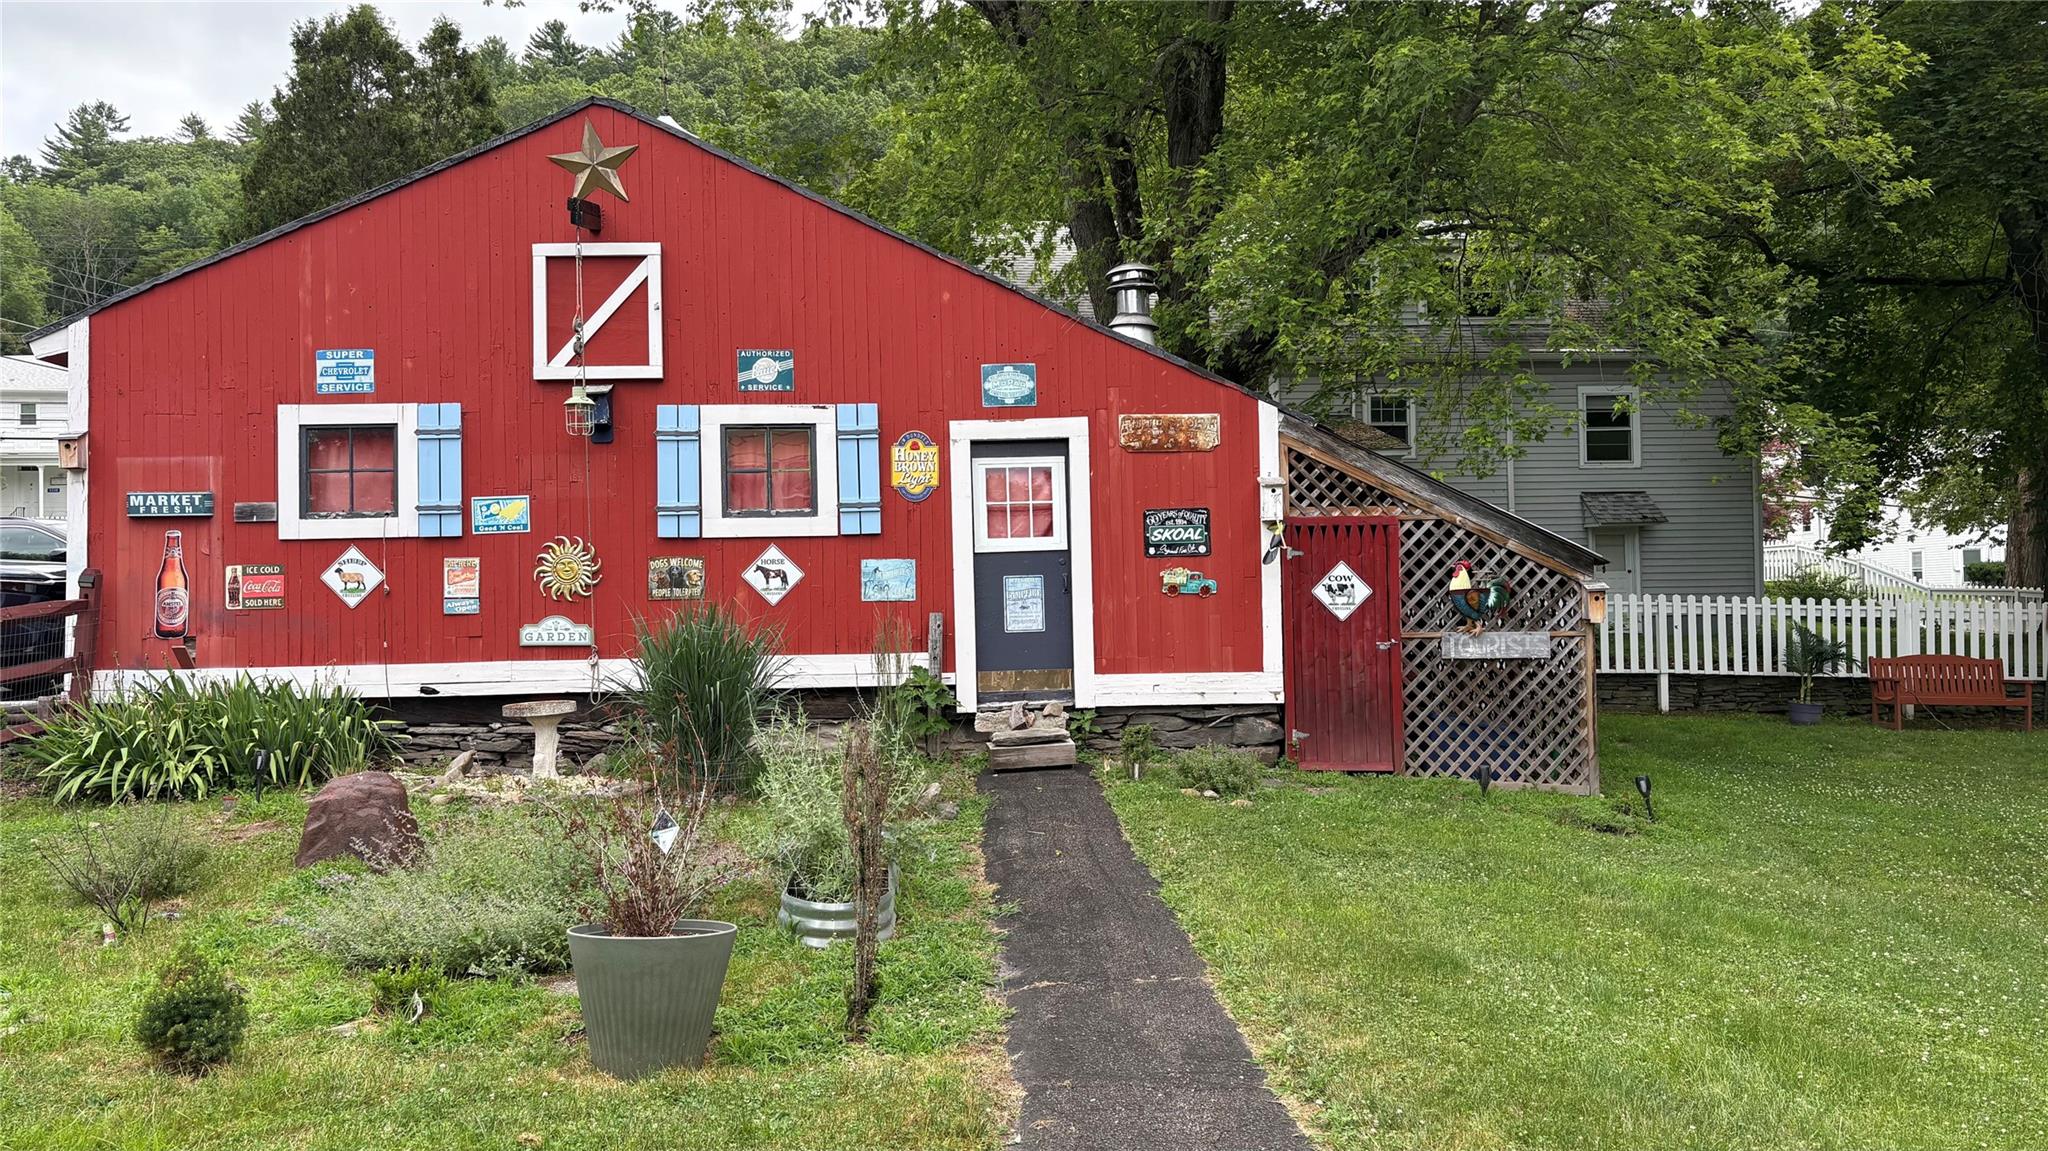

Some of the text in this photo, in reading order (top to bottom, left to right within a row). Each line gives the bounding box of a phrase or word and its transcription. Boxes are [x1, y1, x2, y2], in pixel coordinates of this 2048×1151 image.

[326, 351, 364, 359] SUPER
[322, 367, 369, 376] CHEVROLET
[321, 383, 370, 392] SERVICE
[894, 448, 936, 462] HONEY
[894, 461, 936, 473] BROWN
[897, 471, 934, 490] Light
[129, 495, 202, 507] MARKET
[139, 506, 193, 514] FRESH
[1146, 514, 1159, 526] 60
[1158, 510, 1178, 521] YEARS
[1183, 511, 1208, 525] QUALITY
[1151, 528, 1203, 542] SKOAL
[650, 557, 703, 570] DOGS WELCOME
[760, 558, 786, 566] HORSE
[246, 567, 280, 575] ICE COLD
[652, 588, 671, 597] PEOPLE
[245, 599, 263, 607] SOLD
[525, 632, 587, 642] GARDEN
